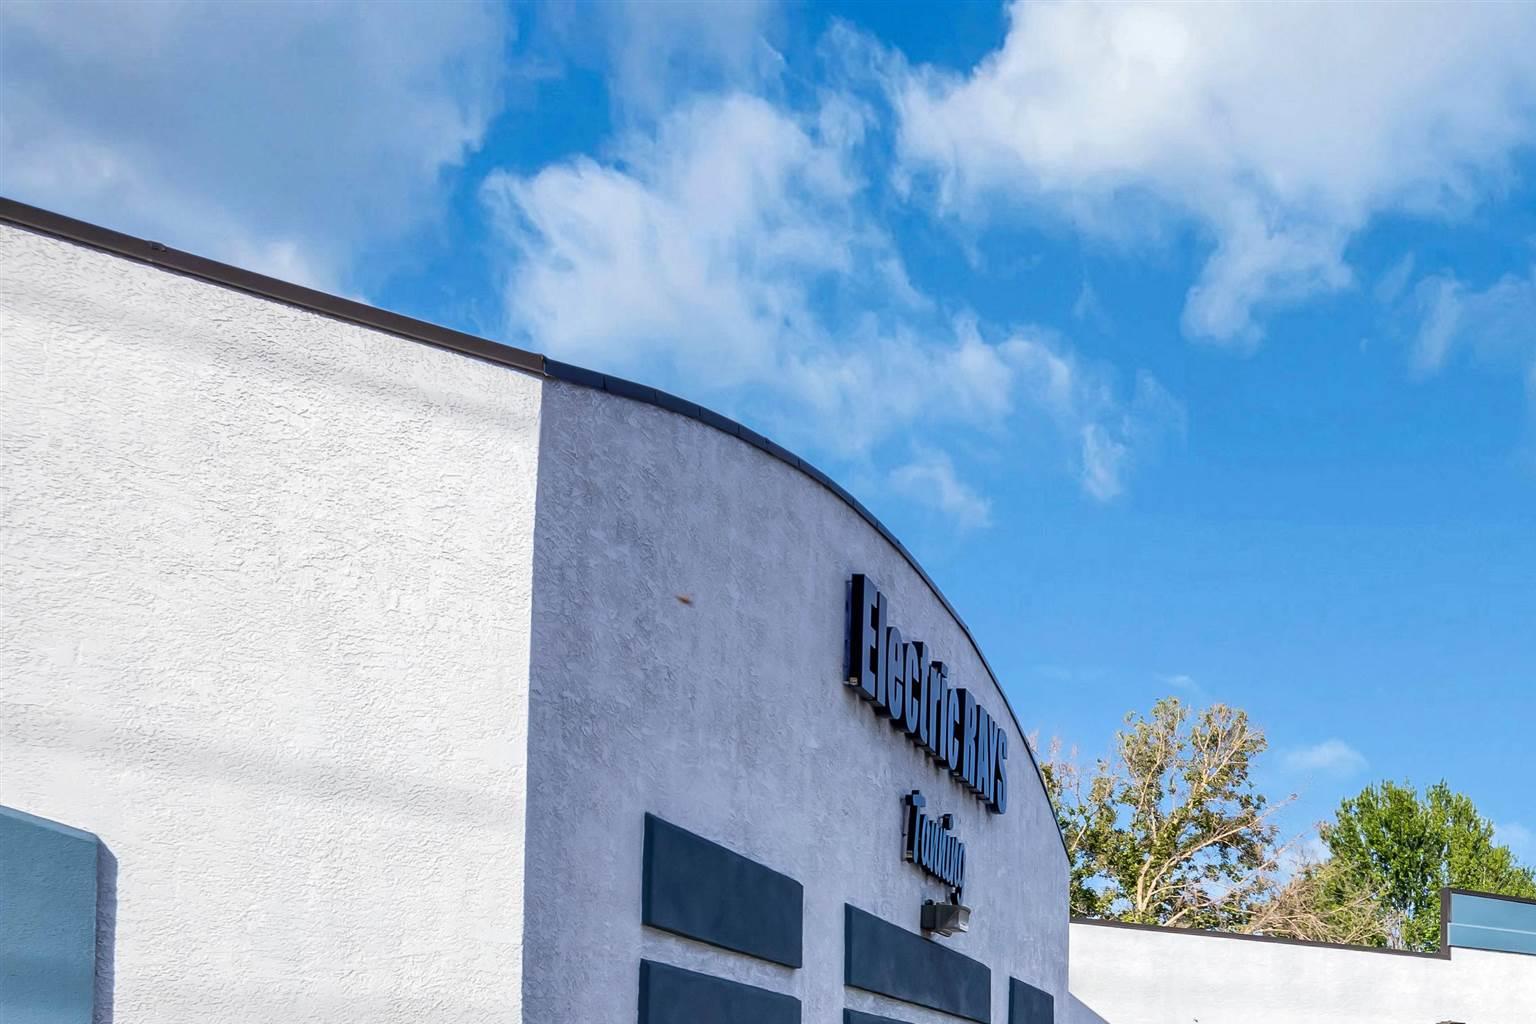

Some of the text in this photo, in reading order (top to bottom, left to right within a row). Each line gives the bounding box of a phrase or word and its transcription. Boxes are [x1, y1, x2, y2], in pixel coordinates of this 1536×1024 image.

[850, 574, 1008, 815] Electric RAYS
[905, 790, 967, 905] Tanning
